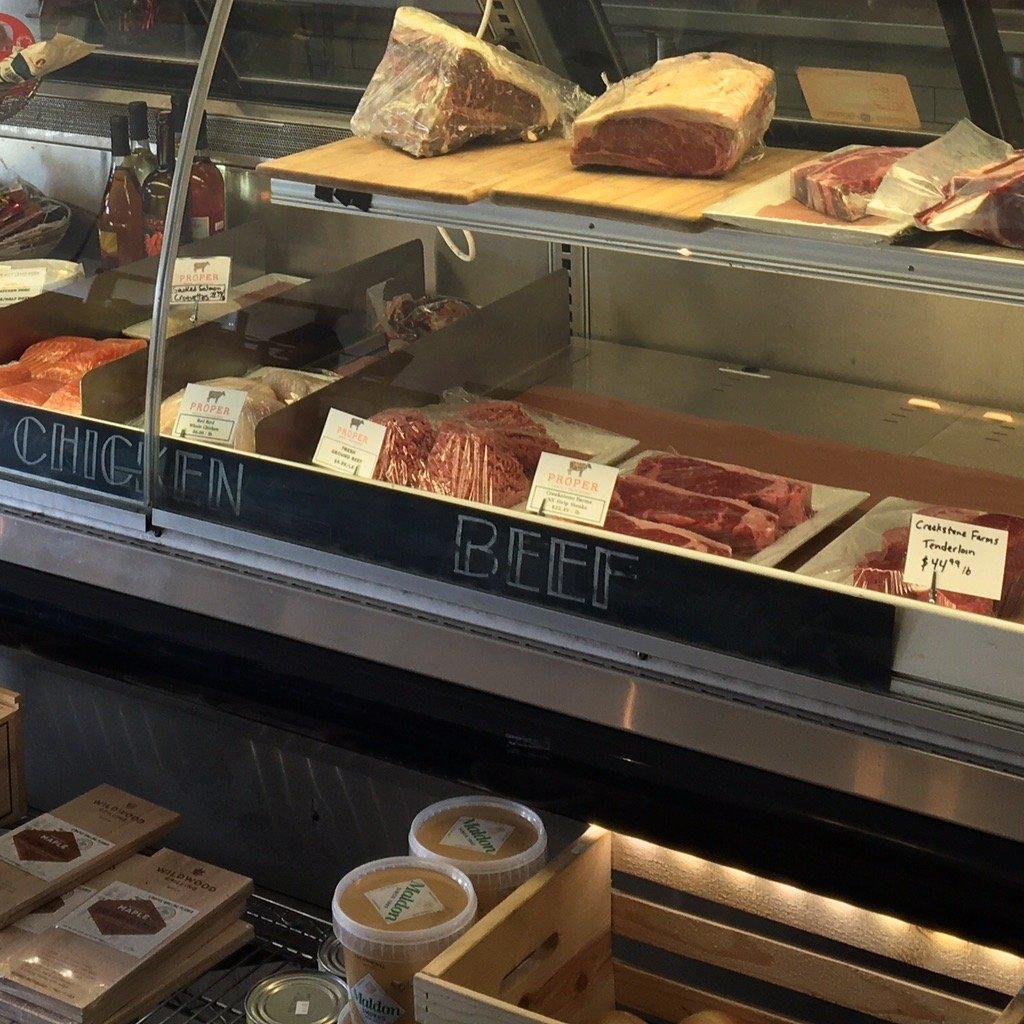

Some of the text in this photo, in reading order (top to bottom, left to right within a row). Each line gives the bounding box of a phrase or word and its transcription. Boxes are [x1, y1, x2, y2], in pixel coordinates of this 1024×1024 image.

[179, 272, 219, 282] PROPER
[190, 402, 230, 416] PROPER
[337, 426, 368, 443] PROPER
[547, 472, 599, 492] PROPER
[916, 520, 999, 545] Creekstone Farms
[923, 539, 976, 556] Tenderloin
[454, 514, 639, 610] BEEF
[40, 833, 69, 850] MAPLE
[463, 816, 496, 854] Maldon
[155, 865, 217, 893] WILDWOOD
[384, 878, 426, 922] Maldon
[116, 903, 152, 922] MAPLE
